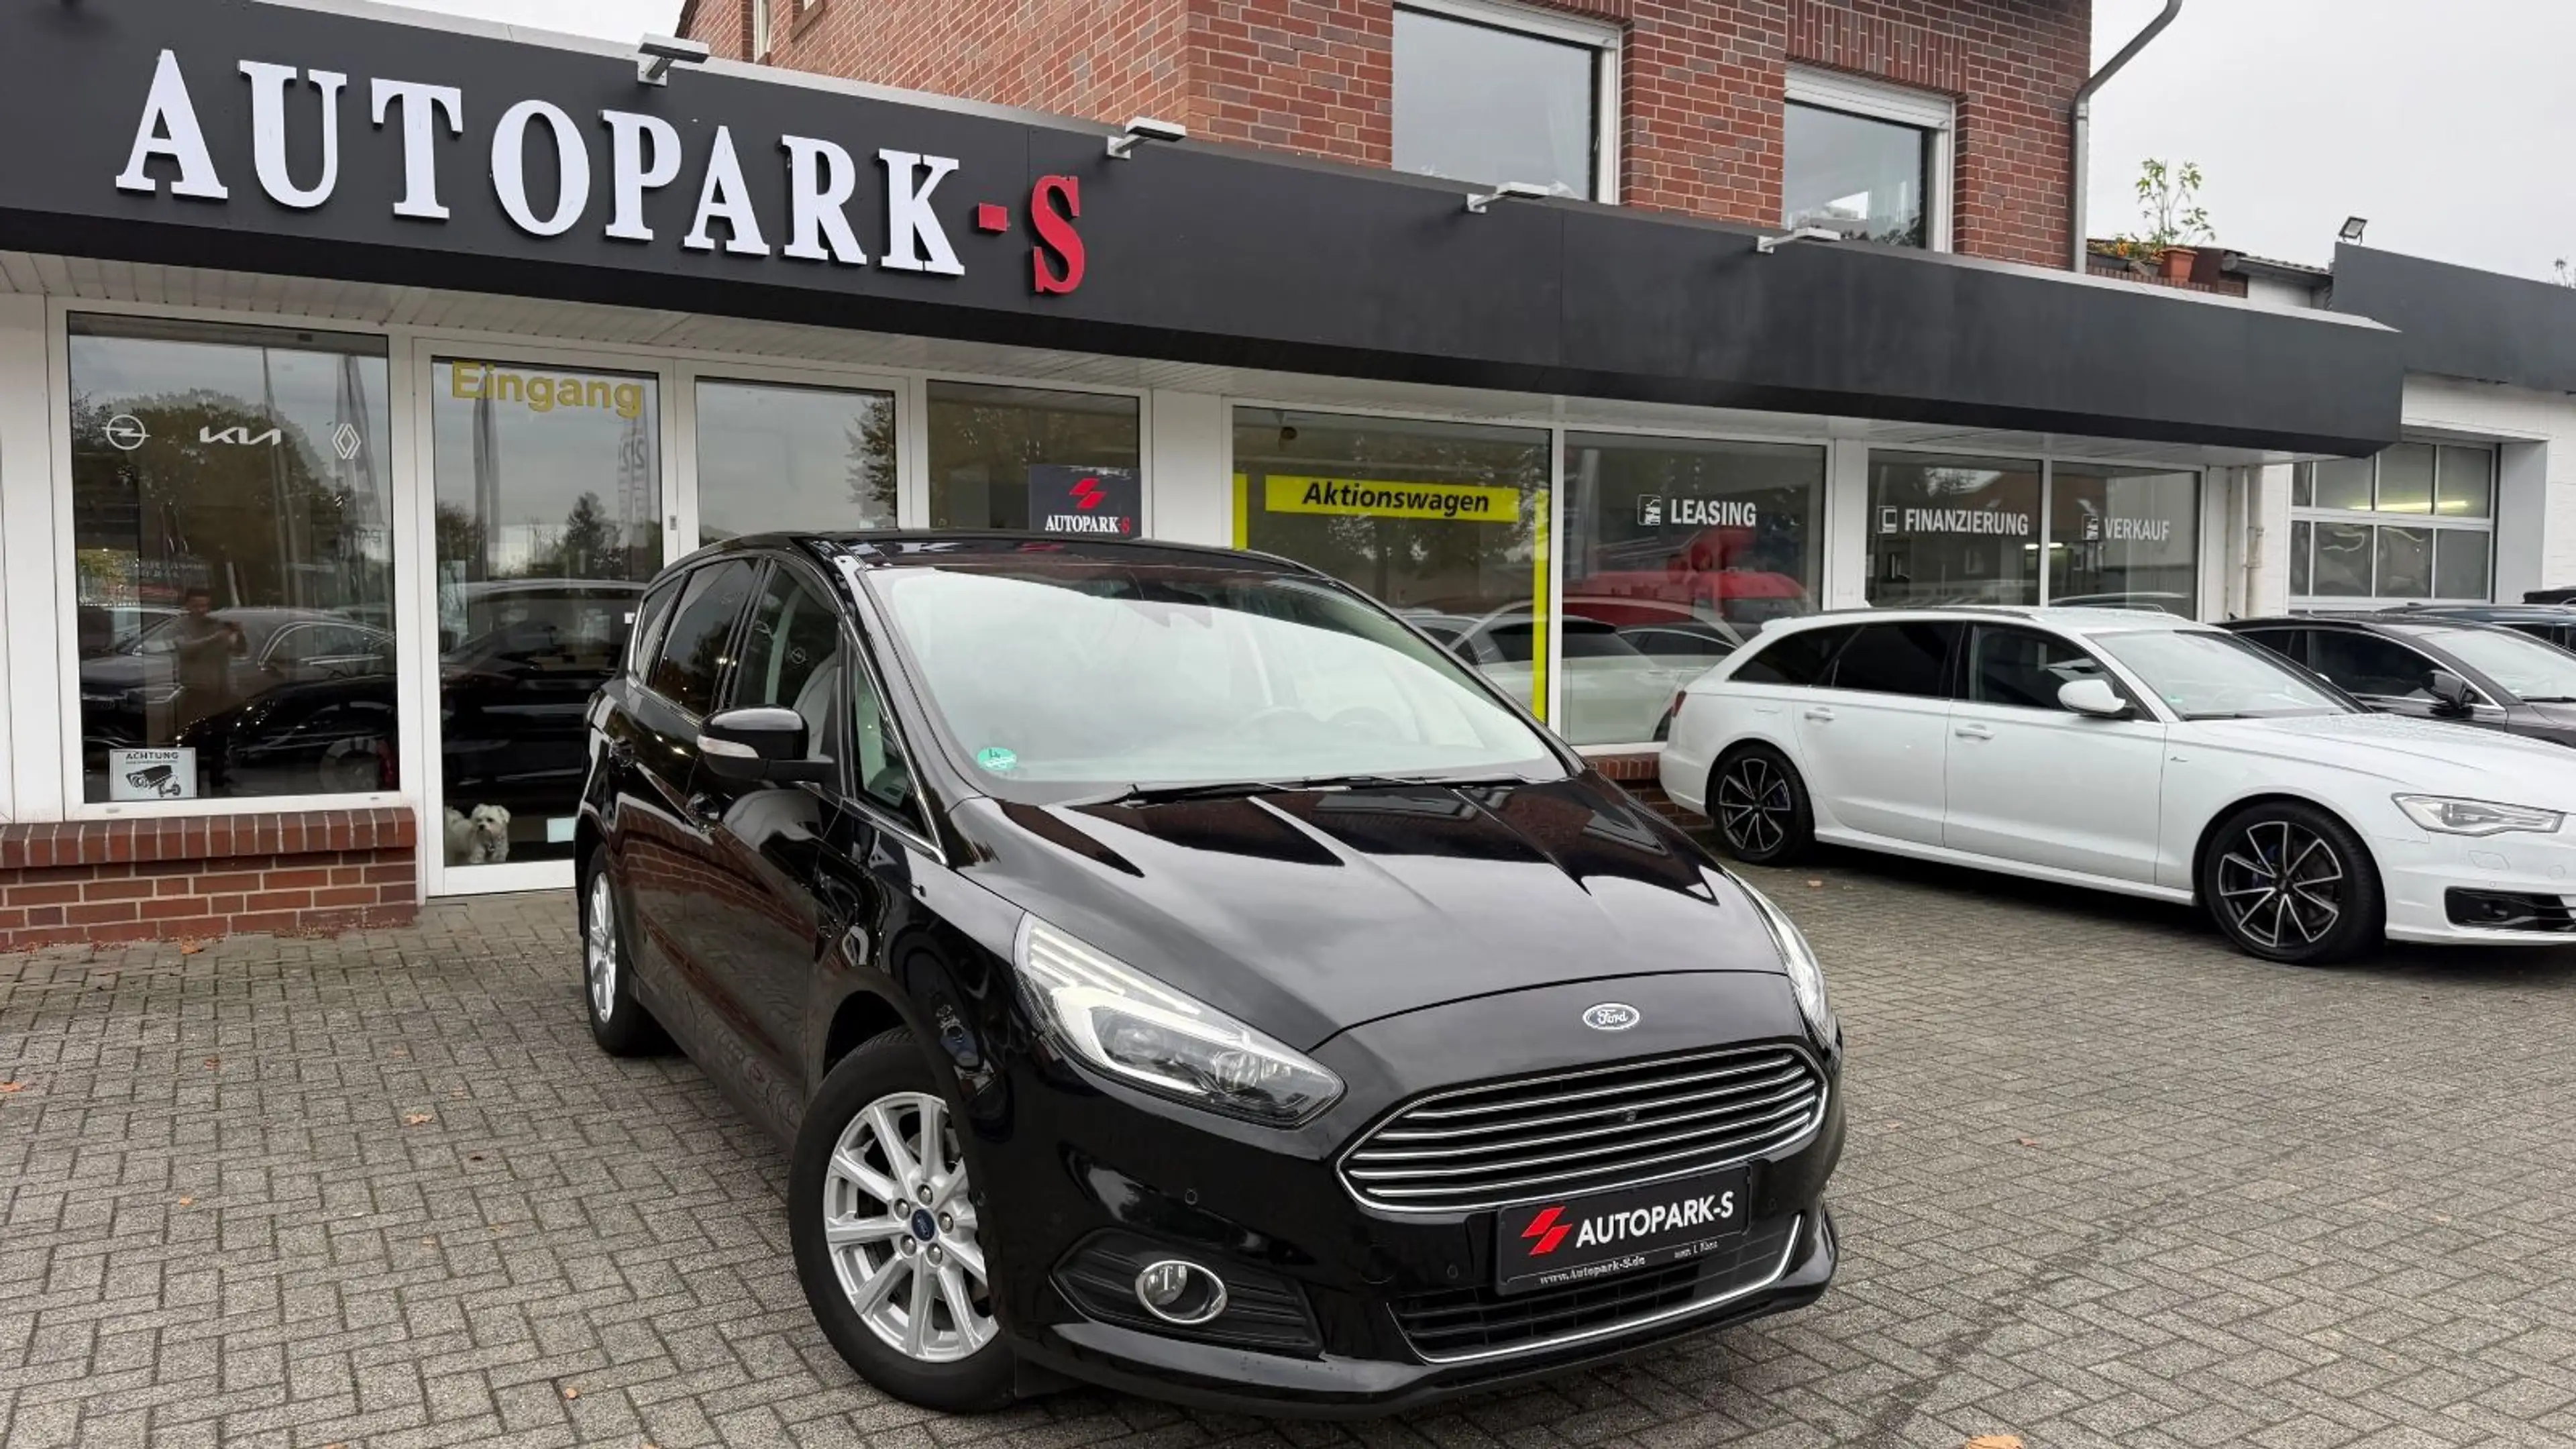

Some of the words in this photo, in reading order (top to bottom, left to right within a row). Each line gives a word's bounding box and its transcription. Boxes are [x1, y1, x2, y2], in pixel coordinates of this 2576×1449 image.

[116, 49, 1085, 294] AUTOPARK-S
[452, 361, 644, 419] Eingang
[1302, 482, 1489, 517] Aktionswagen
[1671, 498, 1756, 527] LEASING
[1904, 508, 2029, 536] FINANZIERUNG
[2104, 517, 2170, 541] VERKAUF
[125, 751, 179, 759] ACHTUNG
[1597, 1009, 1629, 1025] Ford
[1576, 1191, 1734, 1248] AUTOPARK-S
